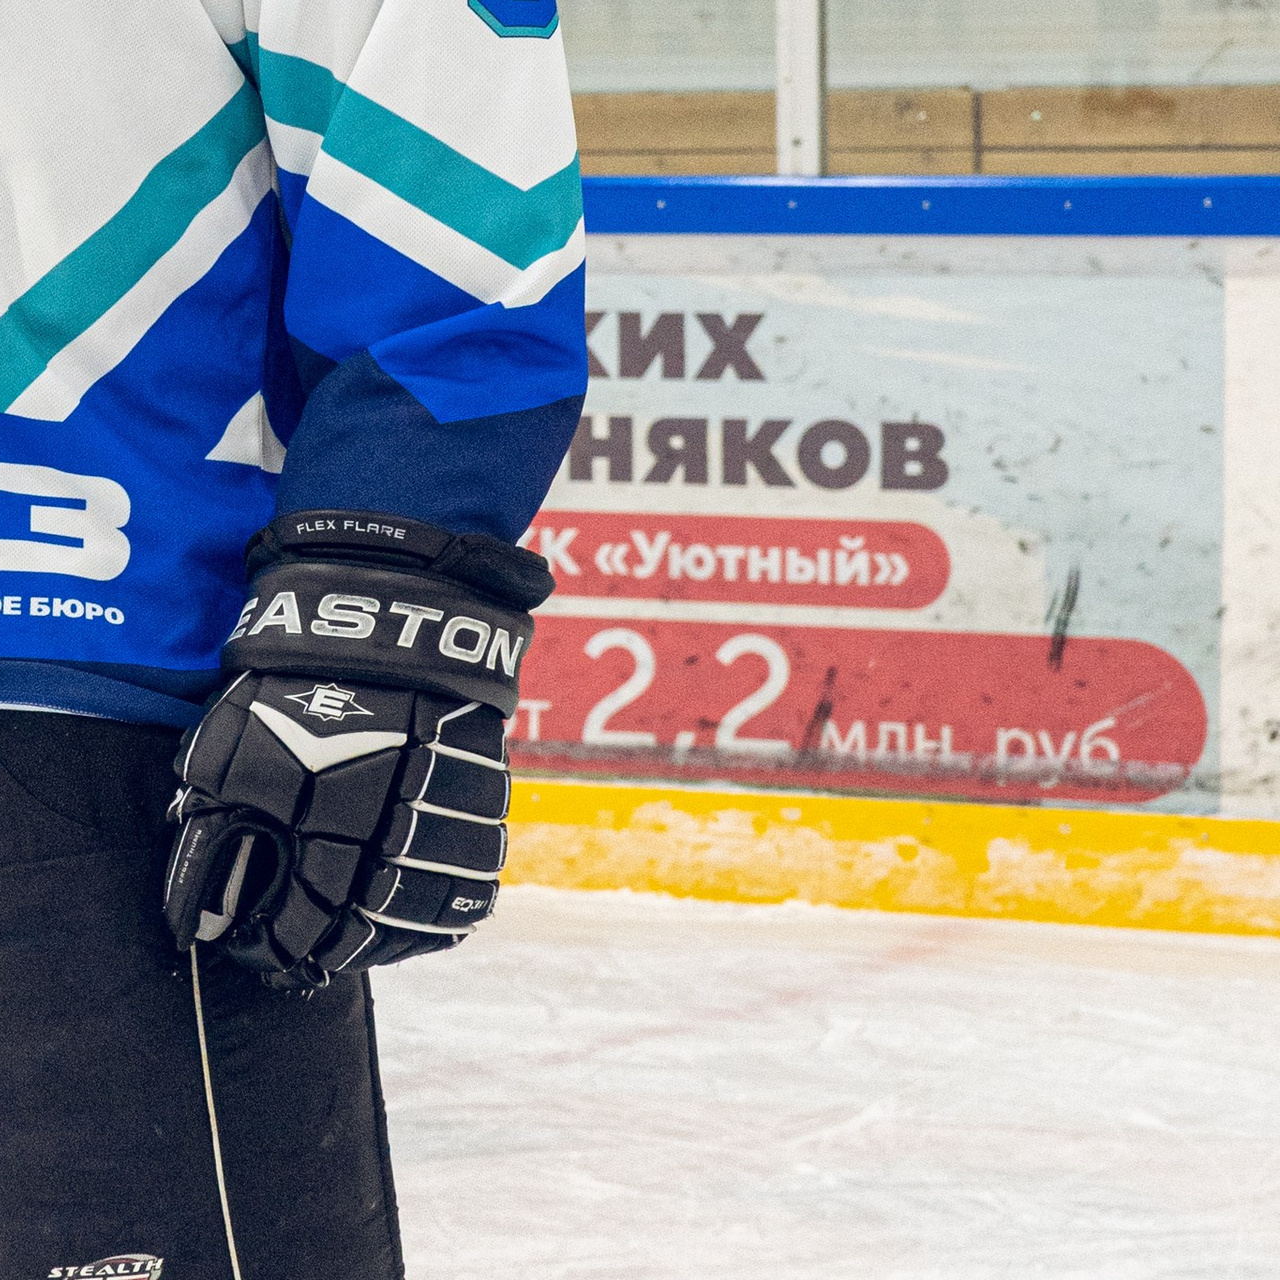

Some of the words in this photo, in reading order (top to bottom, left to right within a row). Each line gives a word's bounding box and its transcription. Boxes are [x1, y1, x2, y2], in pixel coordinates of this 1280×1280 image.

[569, 415, 950, 491] НЯКОВ
[296, 519, 337, 535] FLEX
[344, 520, 407, 541] FLARE
[515, 526, 581, 576] К
[595, 530, 910, 589] «Уютный»
[29, 596, 125, 625] БЮРО
[227, 591, 524, 679] EASTON
[504, 699, 553, 742] т
[583, 627, 792, 762] 2,2
[47, 1257, 165, 1278] STEALTH
